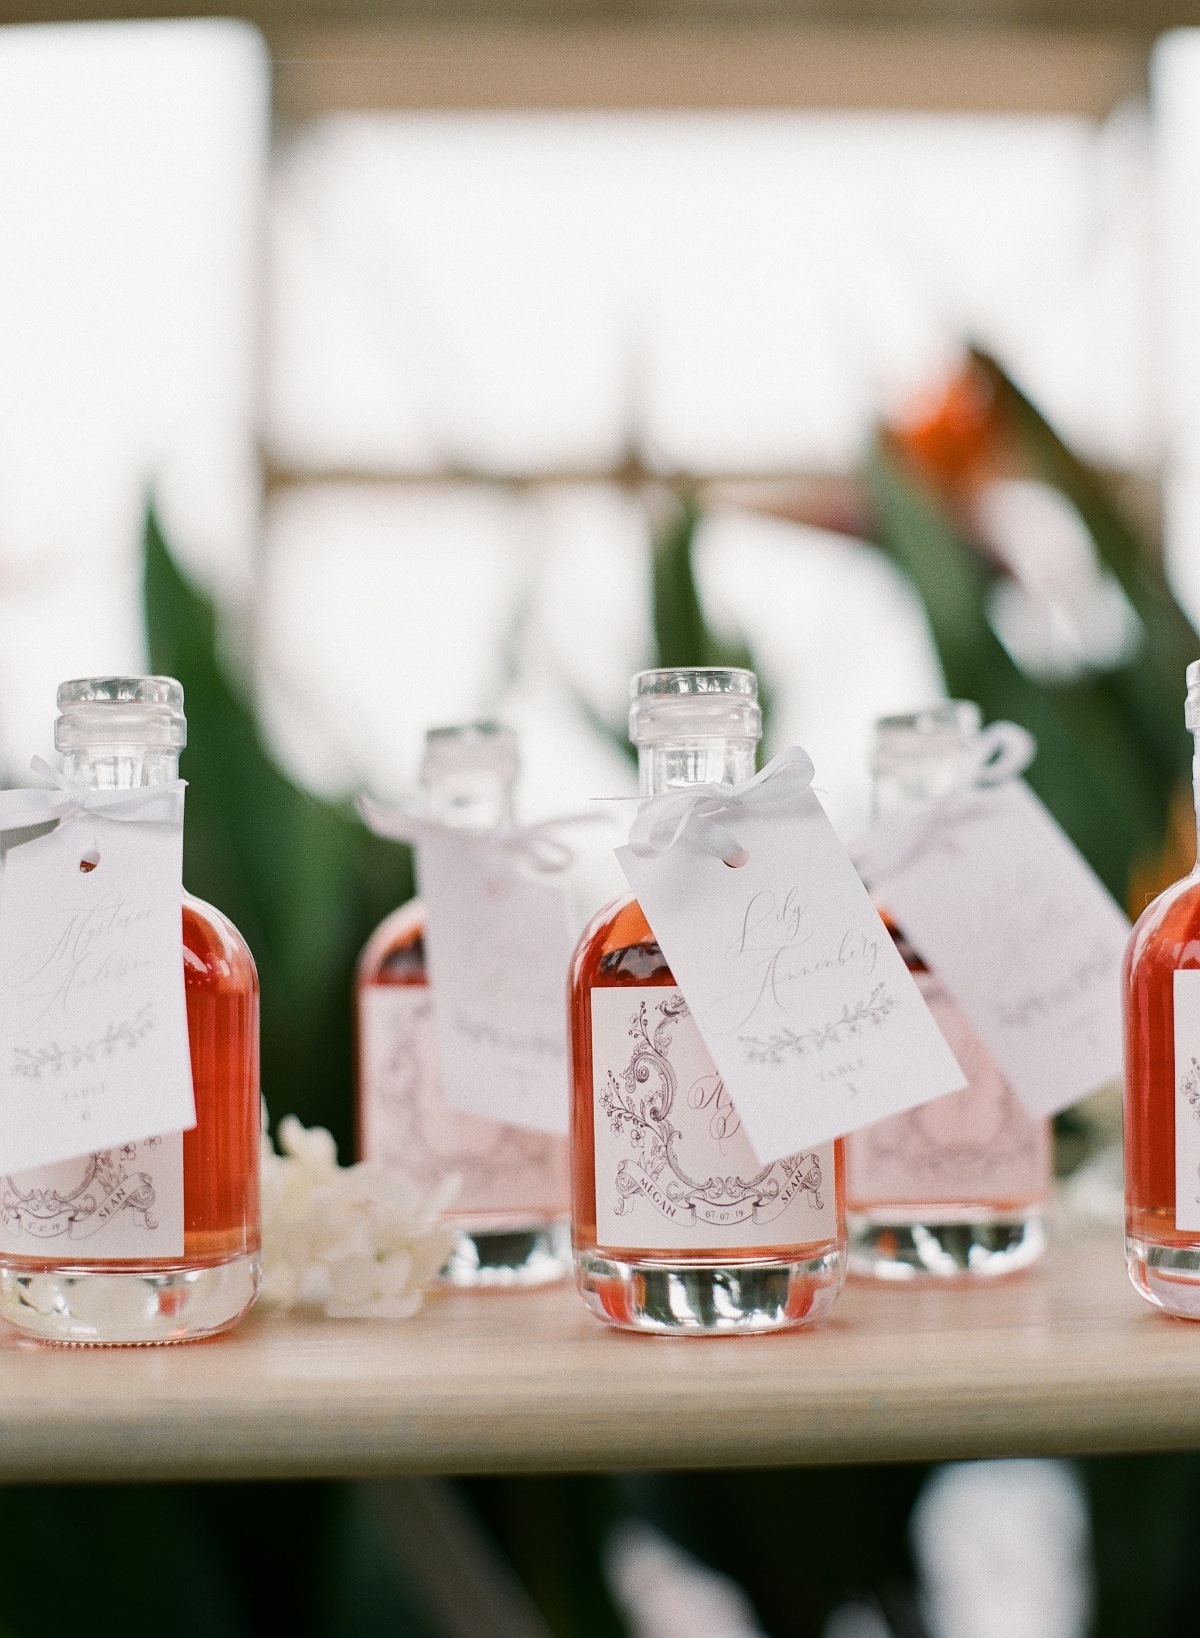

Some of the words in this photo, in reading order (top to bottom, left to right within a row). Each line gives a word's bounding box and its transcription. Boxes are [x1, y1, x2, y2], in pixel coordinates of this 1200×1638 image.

[724, 886, 814, 960] Lily
[98, 1187, 126, 1220] SEAN
[639, 1177, 676, 1217] MEGAN
[781, 1170, 804, 1205] SEAN
